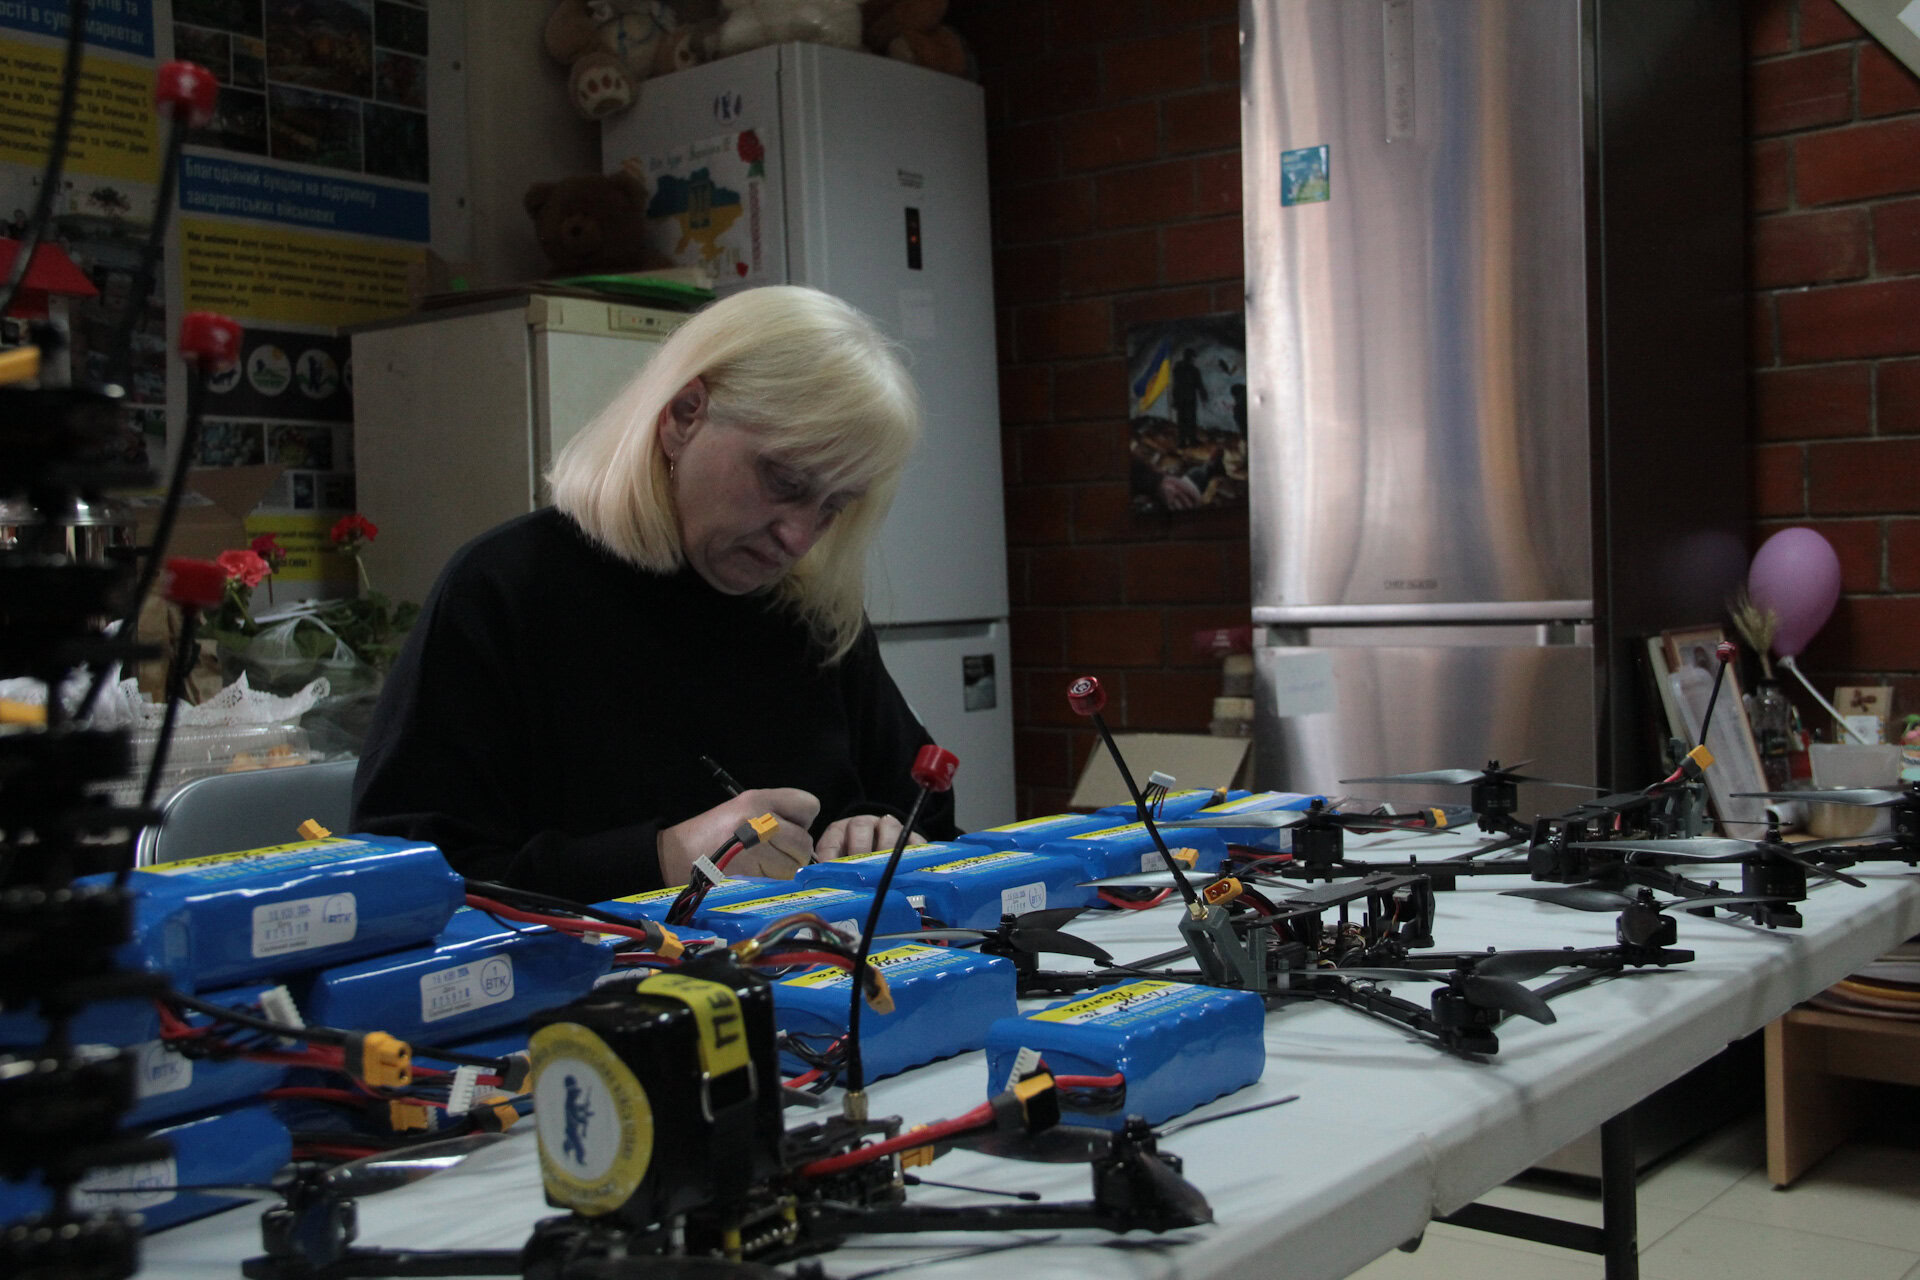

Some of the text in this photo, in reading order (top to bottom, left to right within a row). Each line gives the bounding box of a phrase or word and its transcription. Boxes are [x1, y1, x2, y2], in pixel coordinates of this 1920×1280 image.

[43, 10, 145, 47] супмаркетах
[185, 157, 376, 209] Благодійний аукціон на підтримку
[186, 190, 336, 224] закарпатських військових
